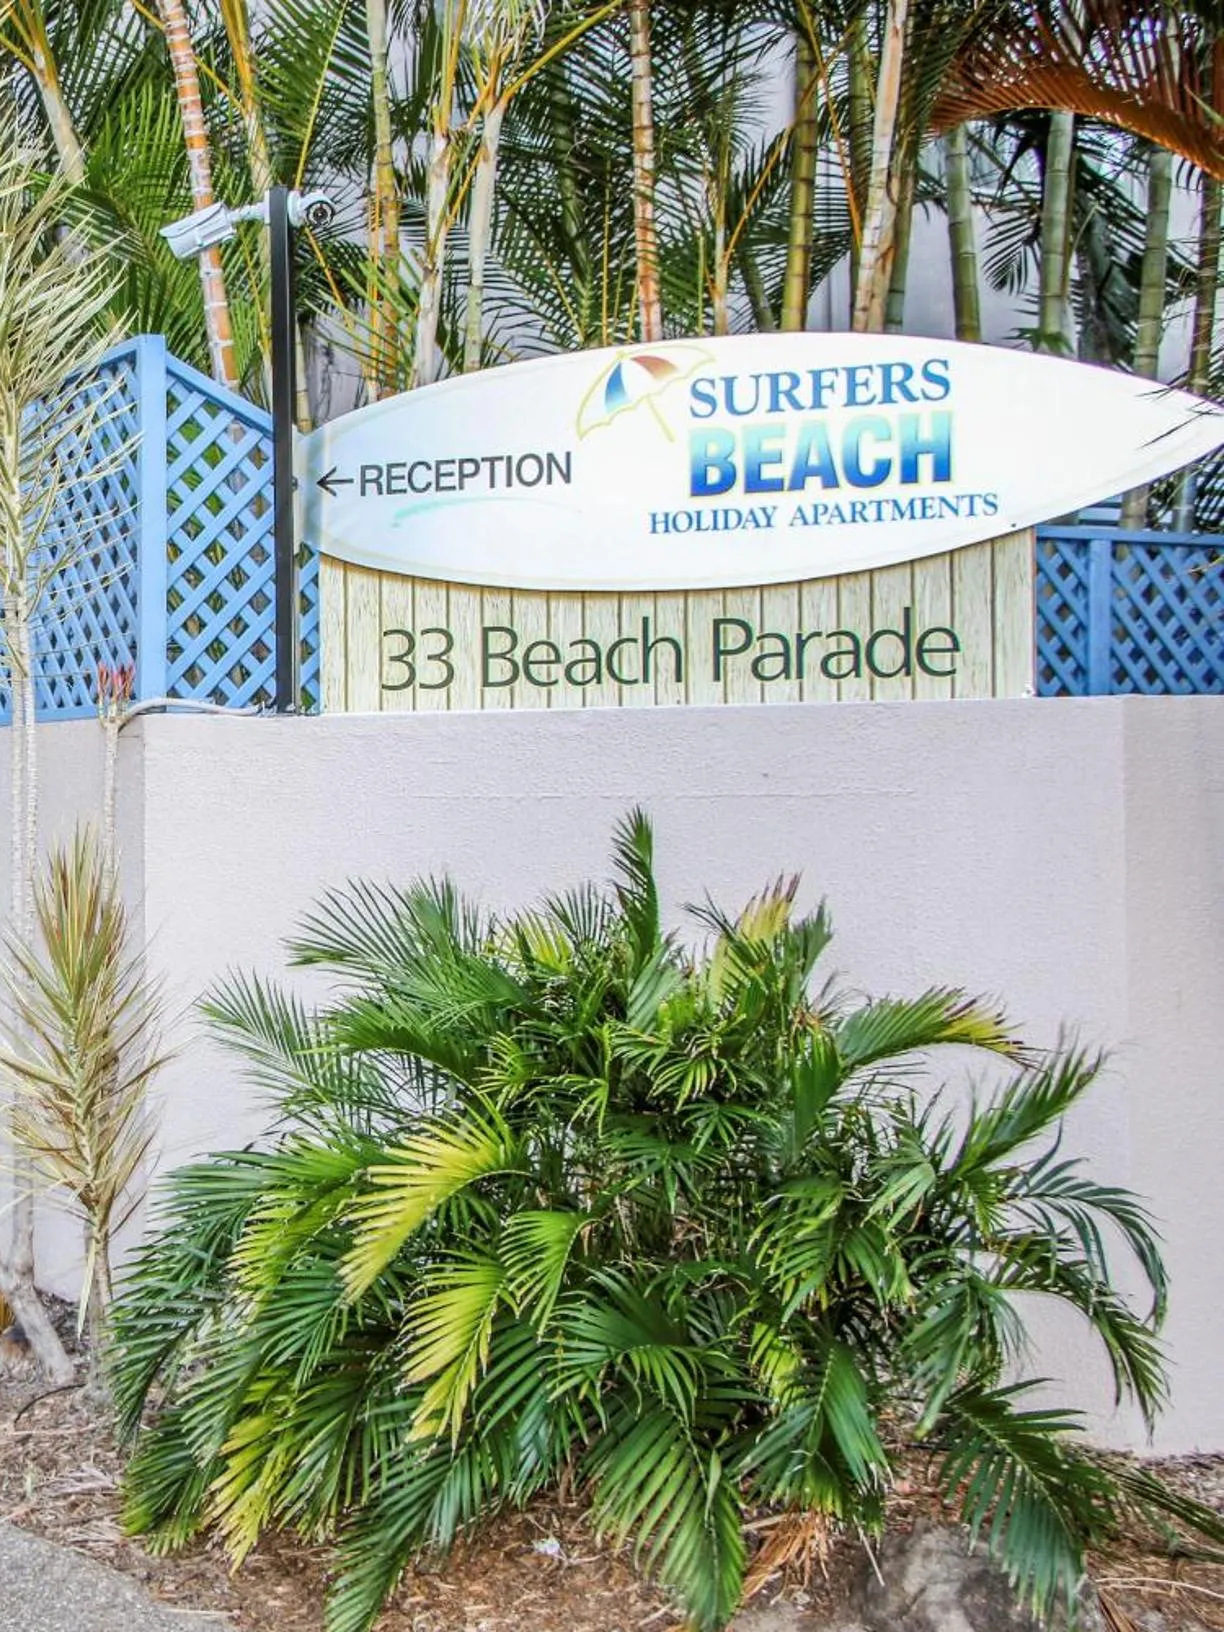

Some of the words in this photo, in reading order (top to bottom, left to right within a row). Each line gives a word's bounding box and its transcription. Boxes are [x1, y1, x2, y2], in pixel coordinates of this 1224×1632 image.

[690, 359, 952, 419] SURFERS
[359, 451, 572, 496] RECEPTION
[690, 410, 954, 497] BEACH
[649, 505, 778, 535] HOLIDAY
[789, 493, 999, 528] APARTMENTS
[381, 628, 456, 691] 33
[481, 616, 683, 689] Beach
[712, 607, 961, 683] Parade
